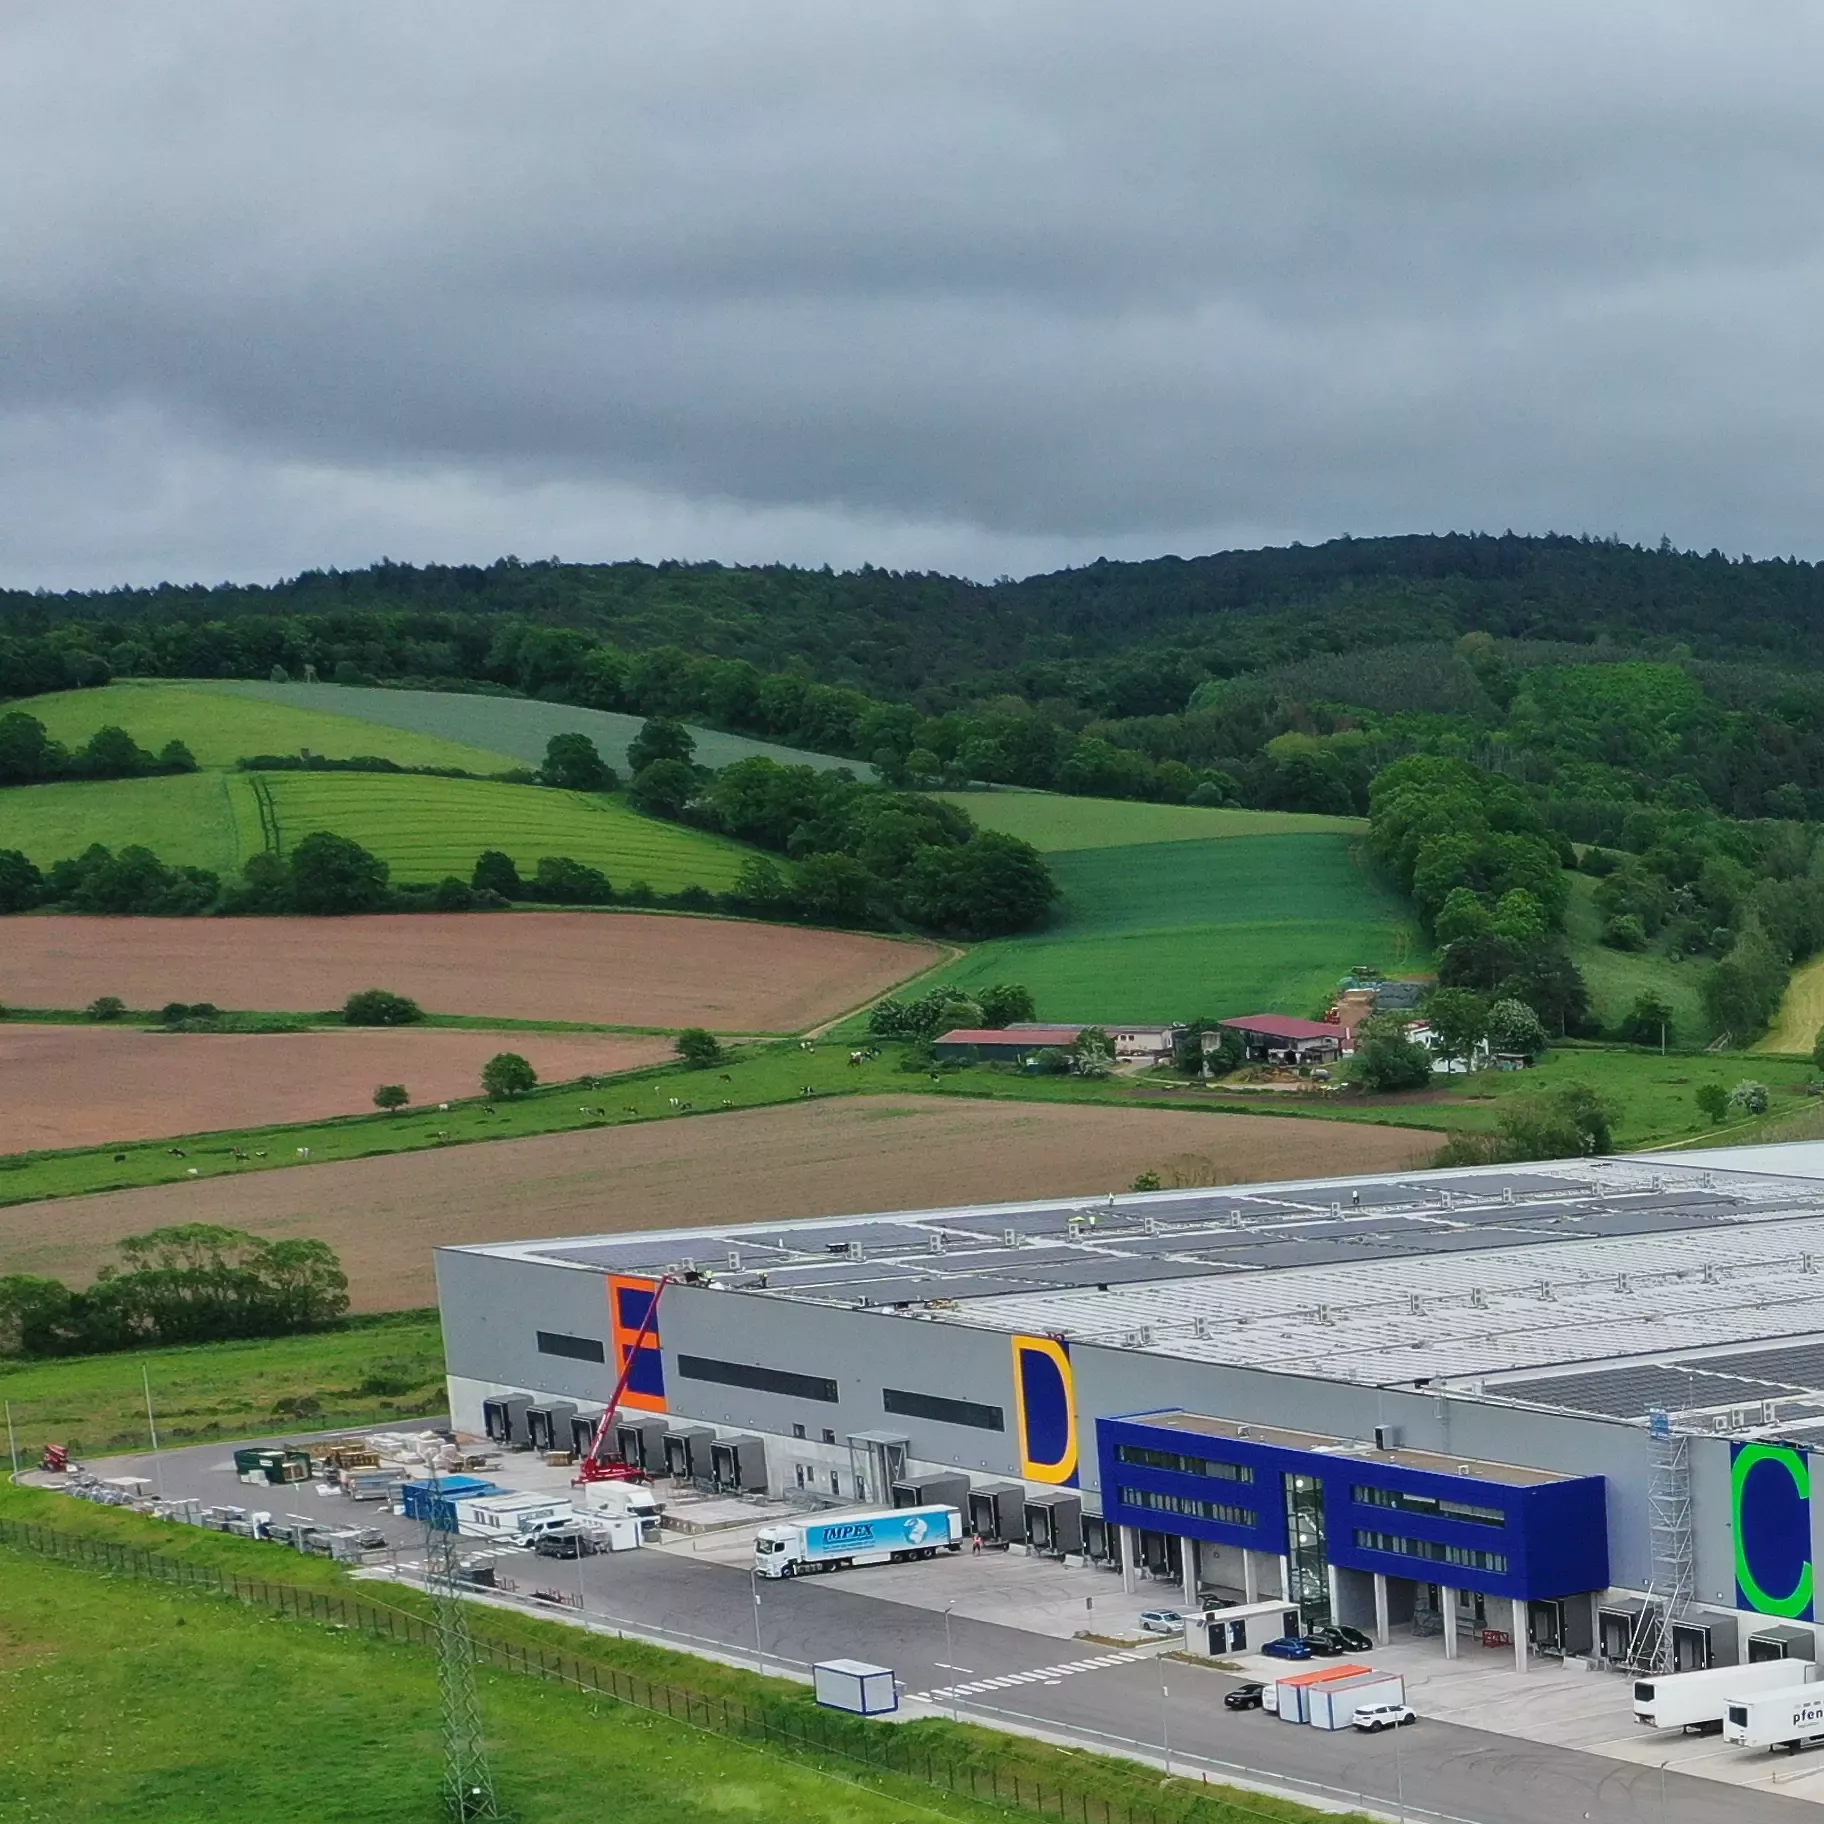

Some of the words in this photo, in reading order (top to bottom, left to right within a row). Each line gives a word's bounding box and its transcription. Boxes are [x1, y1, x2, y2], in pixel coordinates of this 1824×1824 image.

[608, 1275, 668, 1413] E
[1011, 1334, 1077, 1484] D
[823, 1523, 873, 1542] IMPEX
[1731, 1443, 1815, 1617] C
